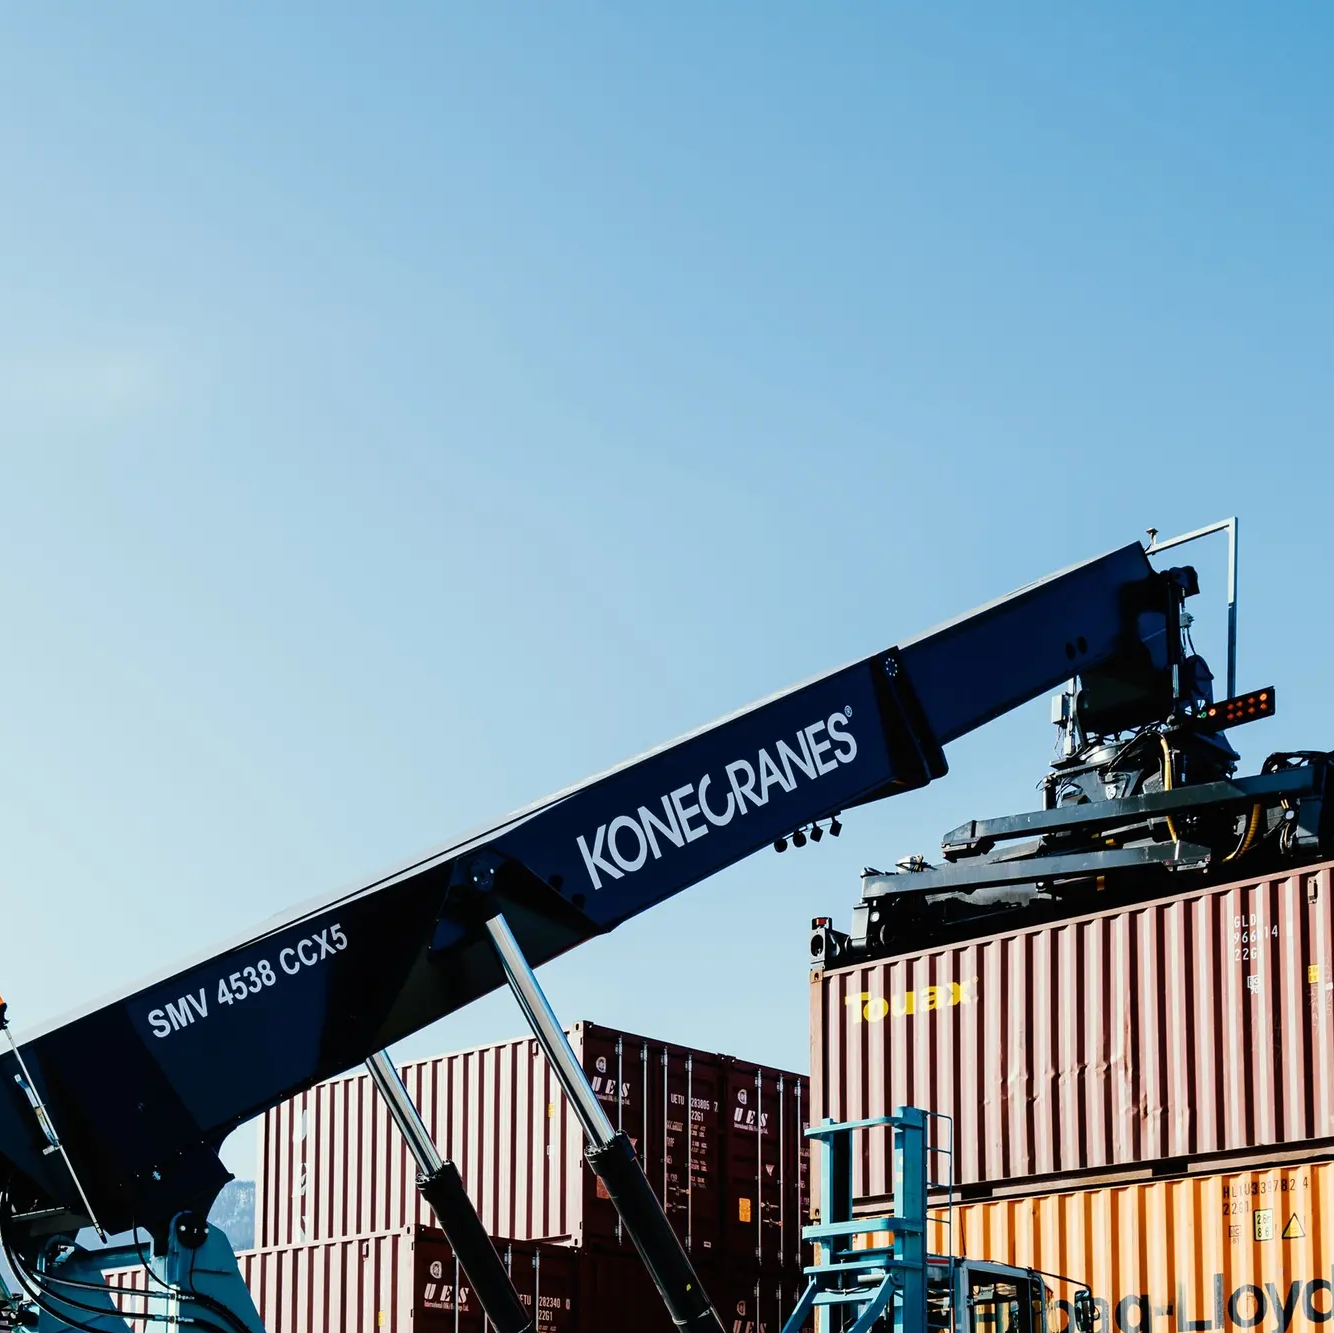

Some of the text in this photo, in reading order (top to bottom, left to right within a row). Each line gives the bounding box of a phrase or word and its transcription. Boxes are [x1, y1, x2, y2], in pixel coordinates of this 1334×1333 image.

[576, 709, 858, 890] KONECRANES
[1234, 913, 1257, 928] GLD
[1234, 925, 1278, 944] 96614
[1234, 947, 1257, 961] 22G
[147, 922, 348, 1038] SMV 4538 CCX5
[845, 979, 973, 1023] Touax
[592, 1076, 631, 1097] UES
[734, 1107, 768, 1127] UES
[424, 1283, 469, 1304] UES
[519, 1294, 531, 1306] ETU
[539, 1296, 561, 1309] 282340
[538, 1310, 553, 1321] 22G1
